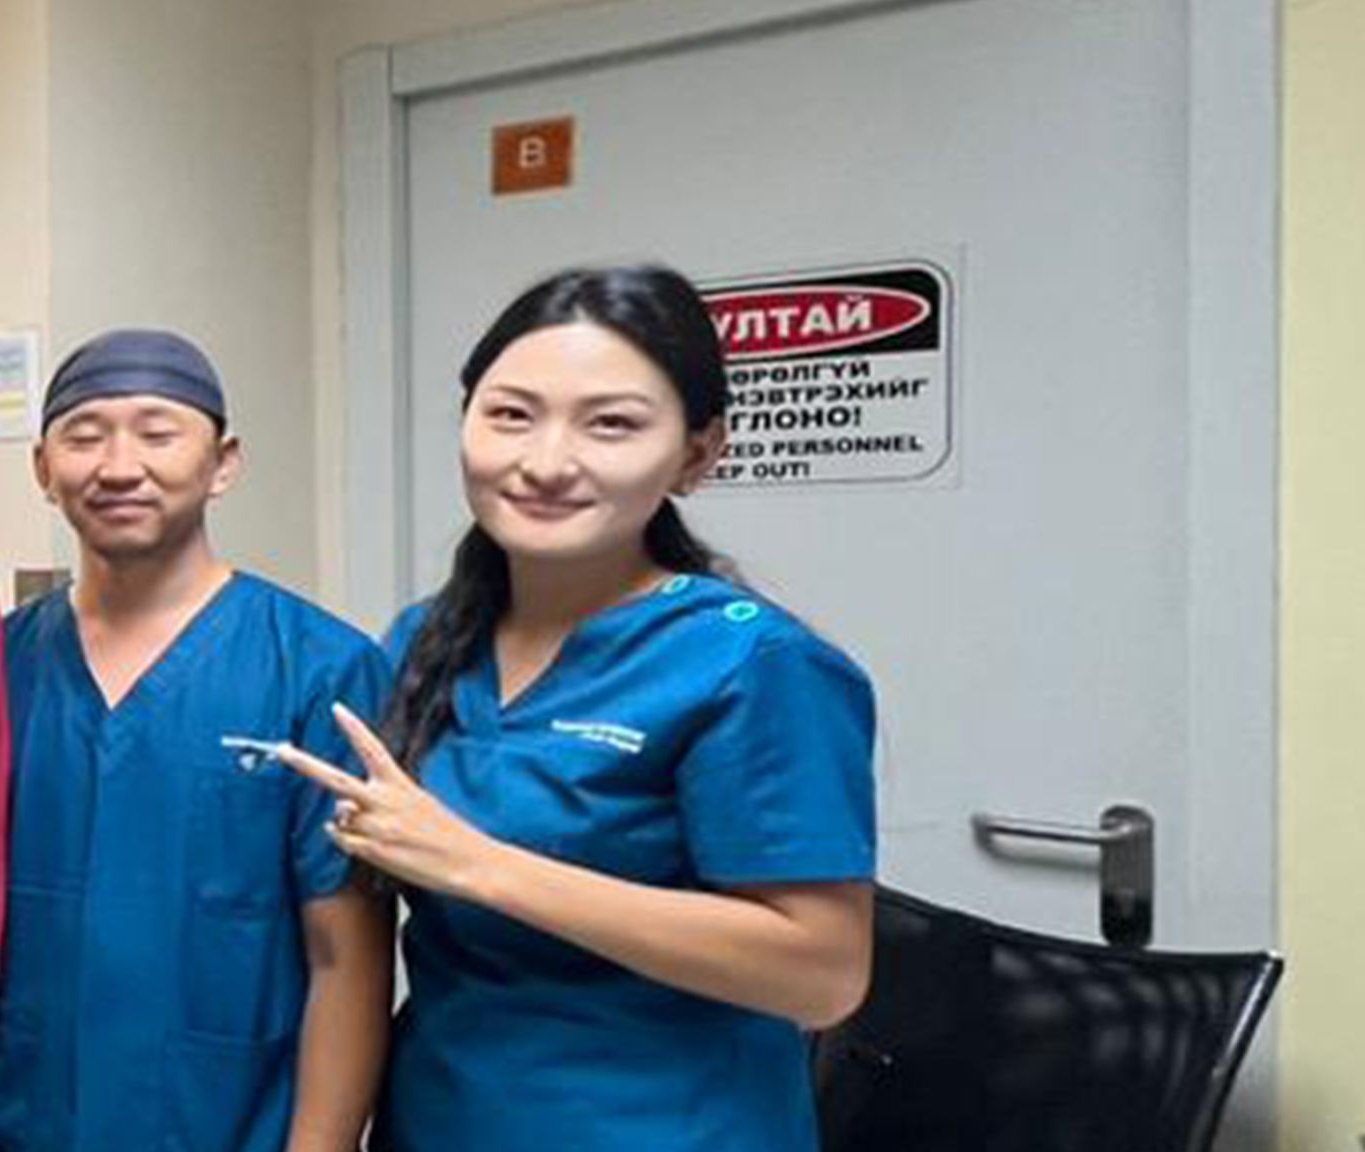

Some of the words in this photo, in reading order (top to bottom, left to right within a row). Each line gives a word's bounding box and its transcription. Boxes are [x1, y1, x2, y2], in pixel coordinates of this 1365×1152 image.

[519, 135, 547, 169] B
[710, 294, 872, 341] УЛТАЙ
[730, 361, 871, 385] ӨРӨЛГҮЙ
[730, 406, 862, 431] ГЛОНО!
[722, 440, 765, 458] ZED
[772, 435, 924, 457] PERSONNEL
